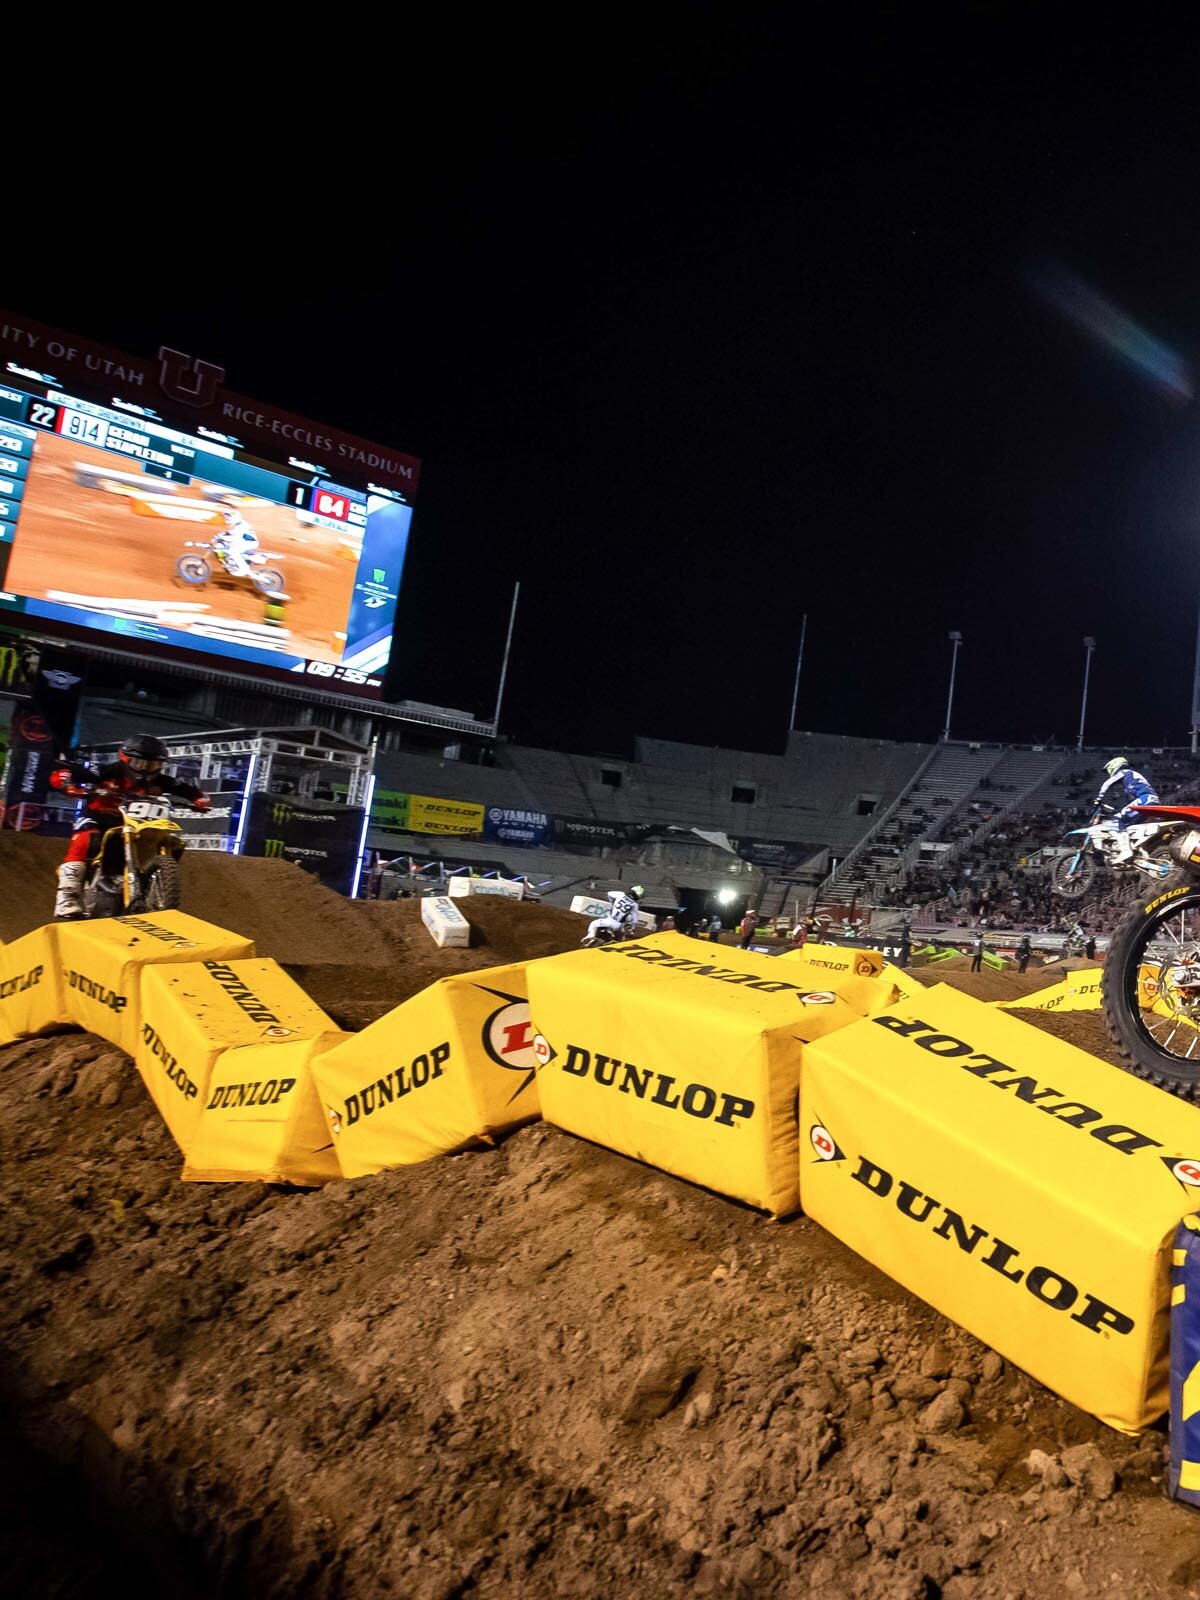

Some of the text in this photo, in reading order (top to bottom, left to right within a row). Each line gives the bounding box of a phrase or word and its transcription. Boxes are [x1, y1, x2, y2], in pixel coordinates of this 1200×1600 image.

[46, 340, 79, 361] OF
[85, 353, 145, 386] UTAH
[29, 403, 56, 428] 22
[69, 415, 100, 441] 914
[222, 402, 334, 451] RICE-ECCLES
[338, 443, 413, 480] STADIUM
[306, 661, 369, 684] 09:55
[127, 802, 170, 819] 90
[424, 821, 478, 833] DUNLOP
[425, 804, 481, 817] DUNLOP
[503, 809, 547, 825] YAMAHA
[1144, 887, 1191, 914] DUNLOP
[808, 958, 850, 971] DUNLOP
[69, 970, 128, 1013] DUNLOP
[204, 961, 281, 1024] DUNLOP
[143, 1022, 199, 1100] DUNLOP
[206, 1077, 297, 1110] DUNLOP
[344, 1041, 452, 1126] DUNLOP
[562, 1044, 755, 1128] DUNLOP
[880, 1015, 1163, 1156] DUNLOP
[851, 1155, 1136, 1337] DUNLOP
